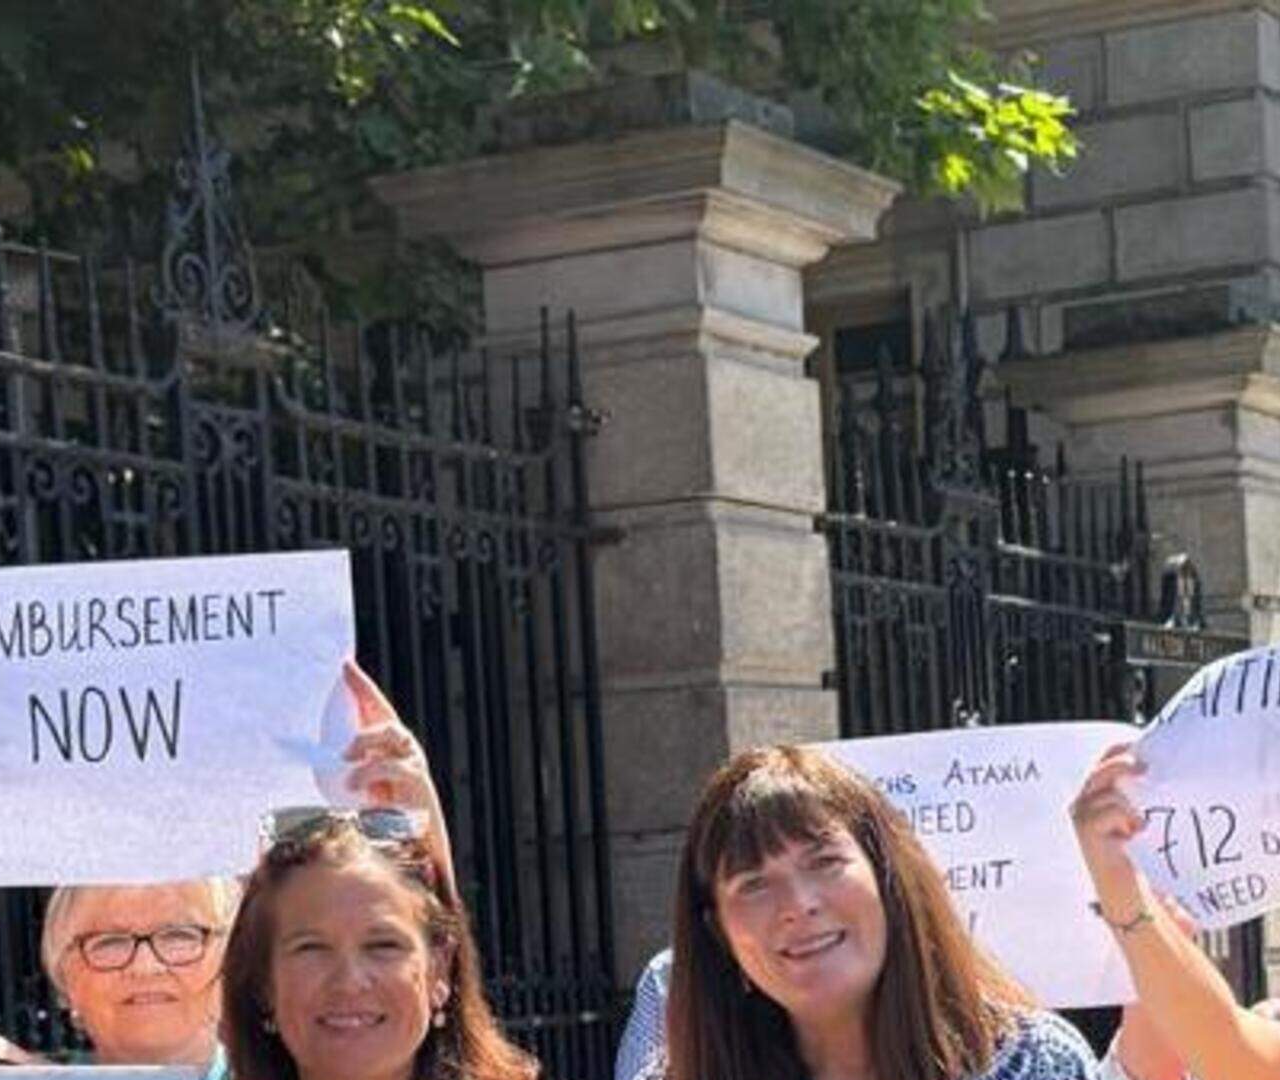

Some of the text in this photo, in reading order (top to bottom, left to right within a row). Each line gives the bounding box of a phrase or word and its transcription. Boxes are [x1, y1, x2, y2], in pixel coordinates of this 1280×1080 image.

[28, 679, 182, 764] NOW
[942, 759, 1041, 788] ATAXIA
[1144, 805, 1243, 879] 712
[1196, 873, 1268, 917] NEED
